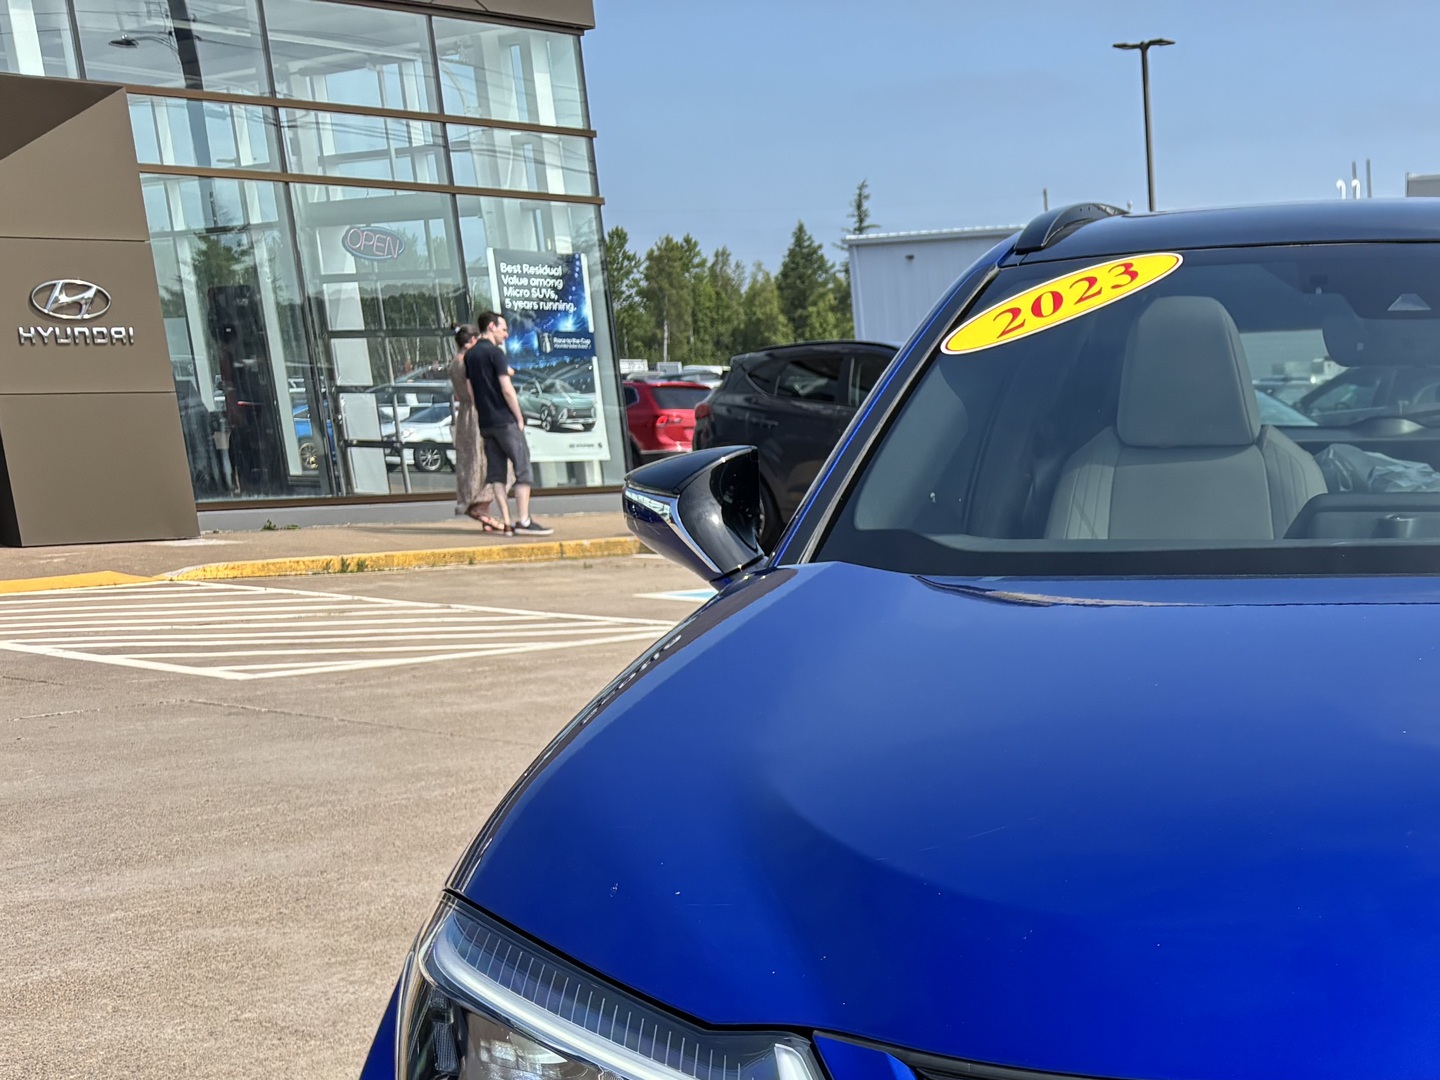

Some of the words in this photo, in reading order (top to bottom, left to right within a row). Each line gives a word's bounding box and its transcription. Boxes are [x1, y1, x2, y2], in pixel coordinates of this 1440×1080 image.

[347, 228, 400, 258] OPEN
[500, 262, 521, 274] Best
[522, 263, 562, 276] Residual
[501, 275, 528, 286] Value
[529, 278, 564, 290] among
[503, 286, 530, 298] Micro
[531, 287, 558, 300] SUVs,
[992, 261, 1140, 340] 2023
[504, 298, 512, 308] 5
[513, 300, 538, 311] years
[539, 300, 577, 313] running.
[18, 326, 135, 345] HYUNDAI
